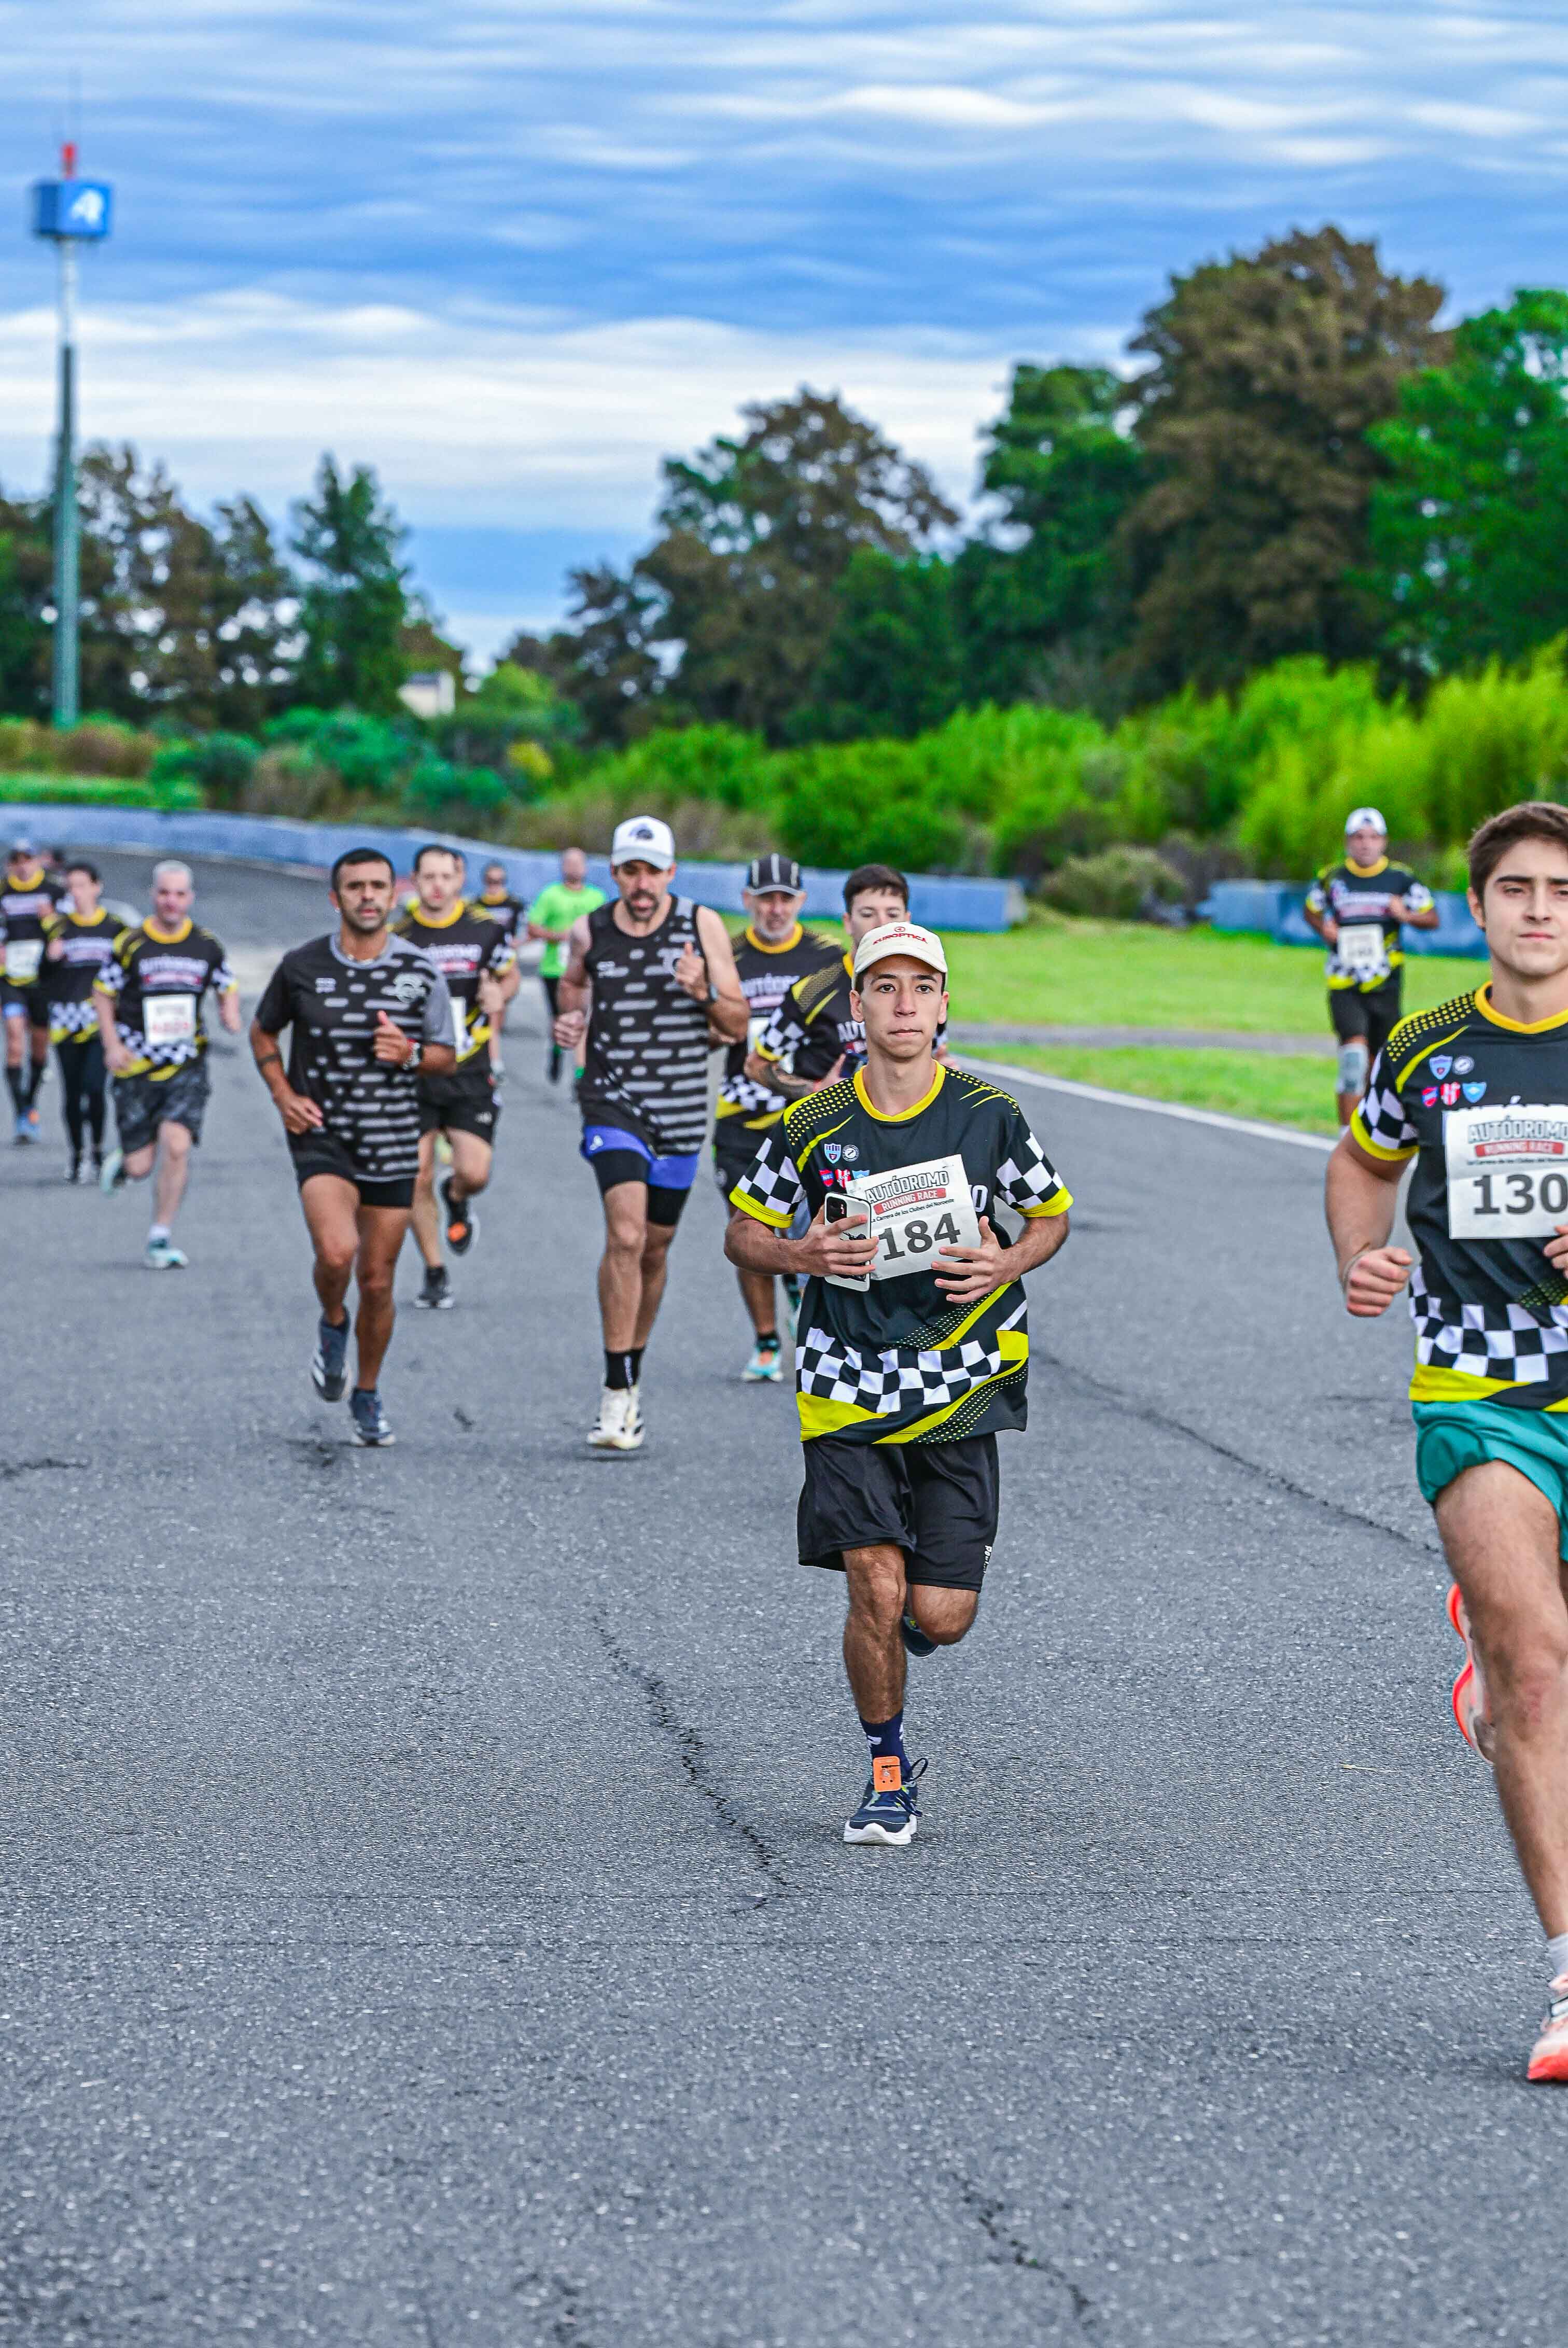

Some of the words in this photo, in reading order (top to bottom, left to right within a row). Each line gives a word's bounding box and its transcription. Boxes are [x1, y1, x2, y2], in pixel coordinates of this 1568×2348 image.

[864, 1170, 949, 1204] AUTÓDROMO
[881, 1193, 916, 1211] RUNNING
[918, 1190, 938, 1201] RACE
[1473, 1173, 1568, 1215] 130
[878, 1212, 961, 1261] 184
